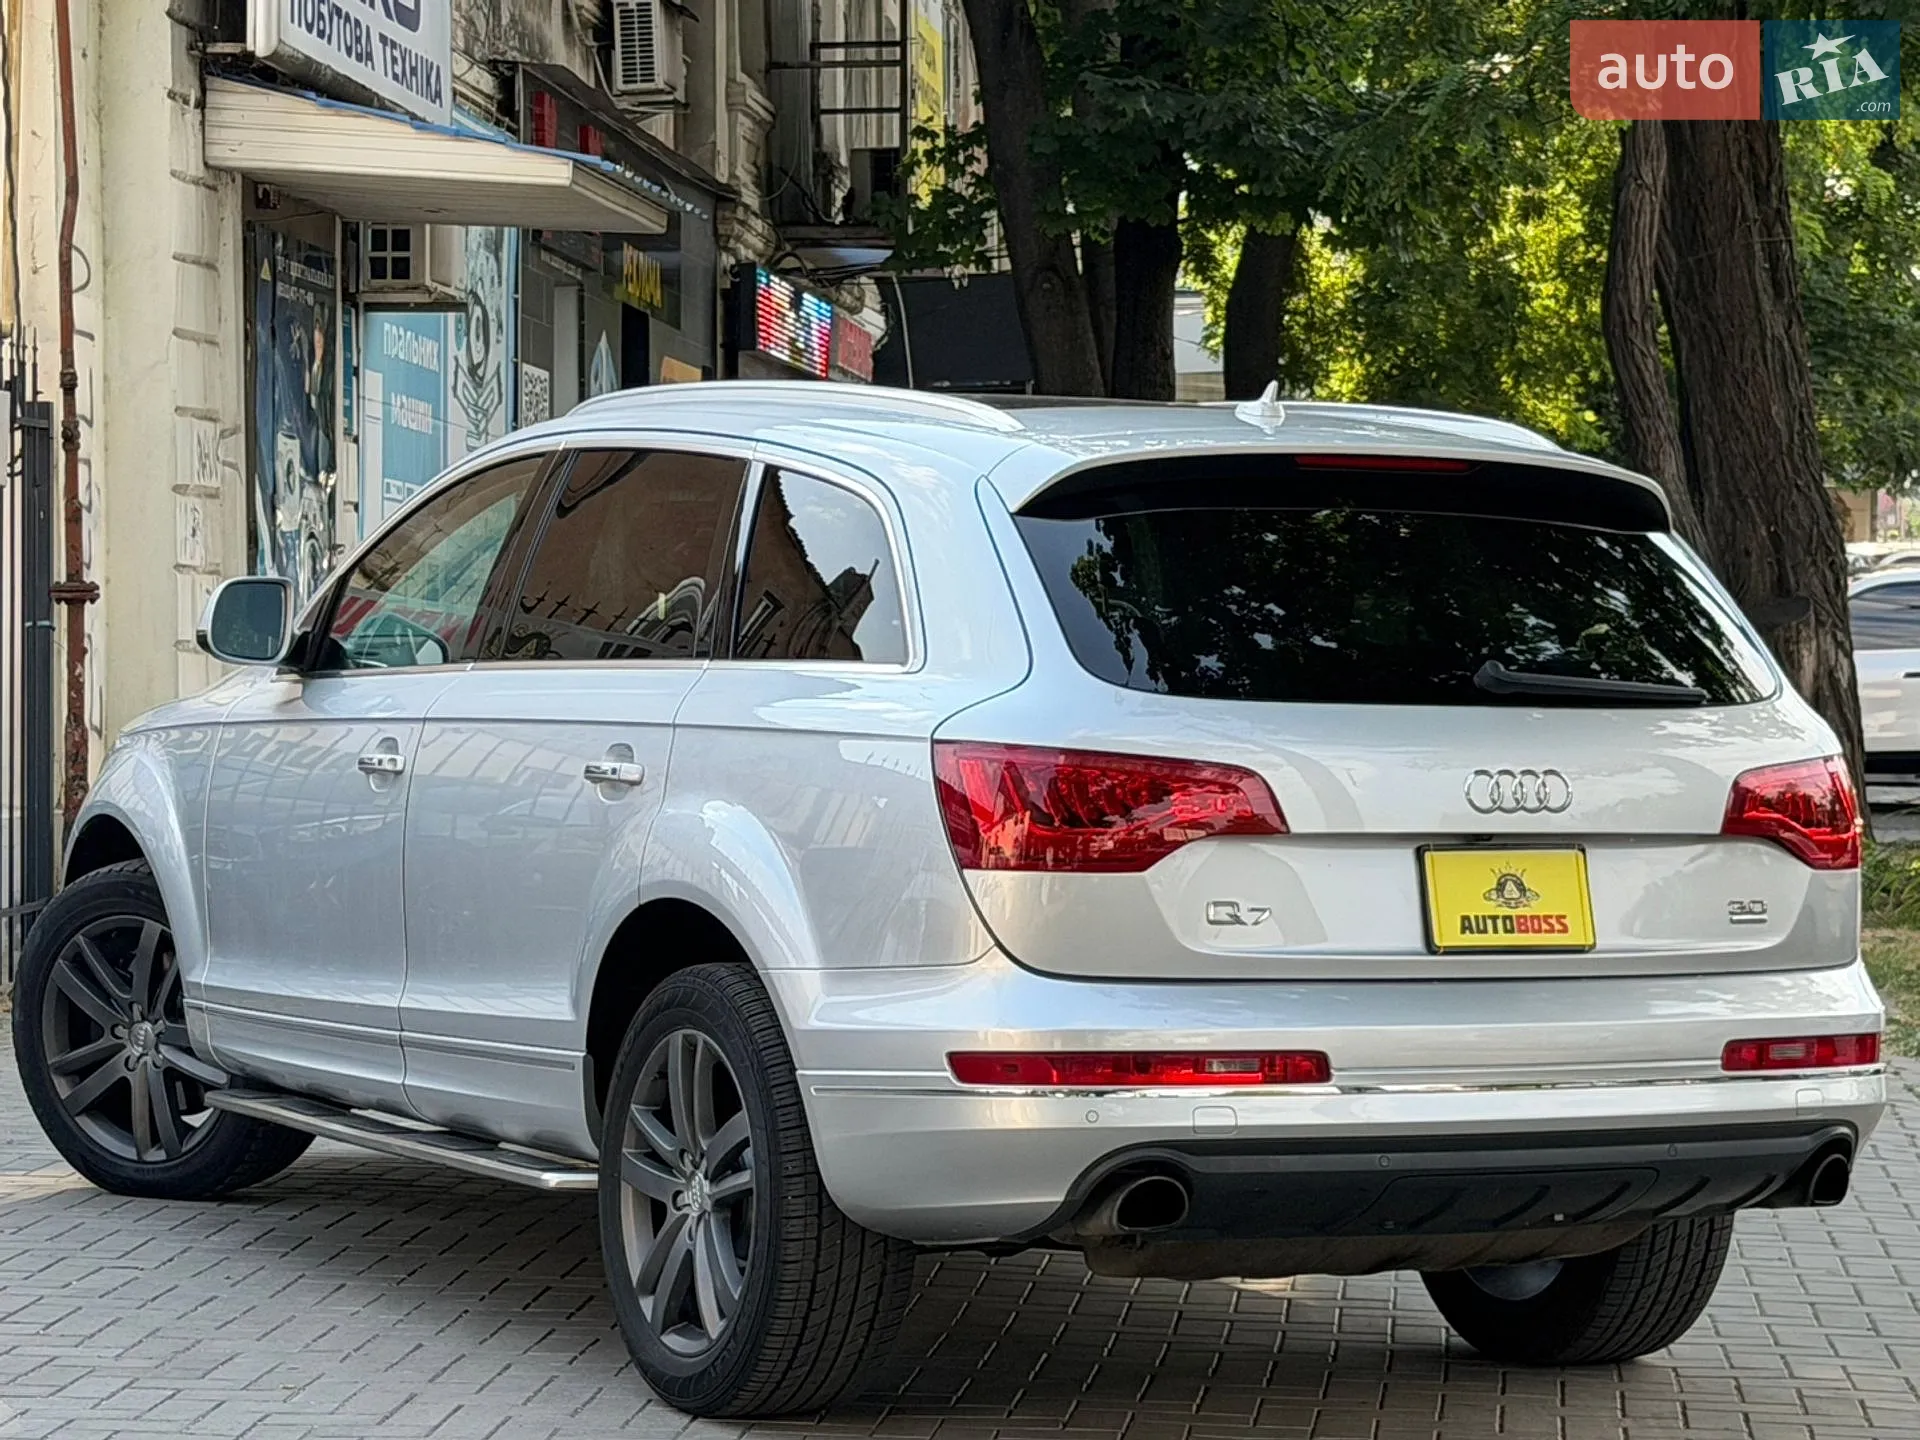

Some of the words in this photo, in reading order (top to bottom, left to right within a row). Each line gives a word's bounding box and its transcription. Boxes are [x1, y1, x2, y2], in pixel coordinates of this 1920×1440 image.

[378, 31, 443, 108] ТЕХНІКА
[1206, 900, 1272, 926] Q7
[1459, 914, 1569, 935] AUTOBOSS
